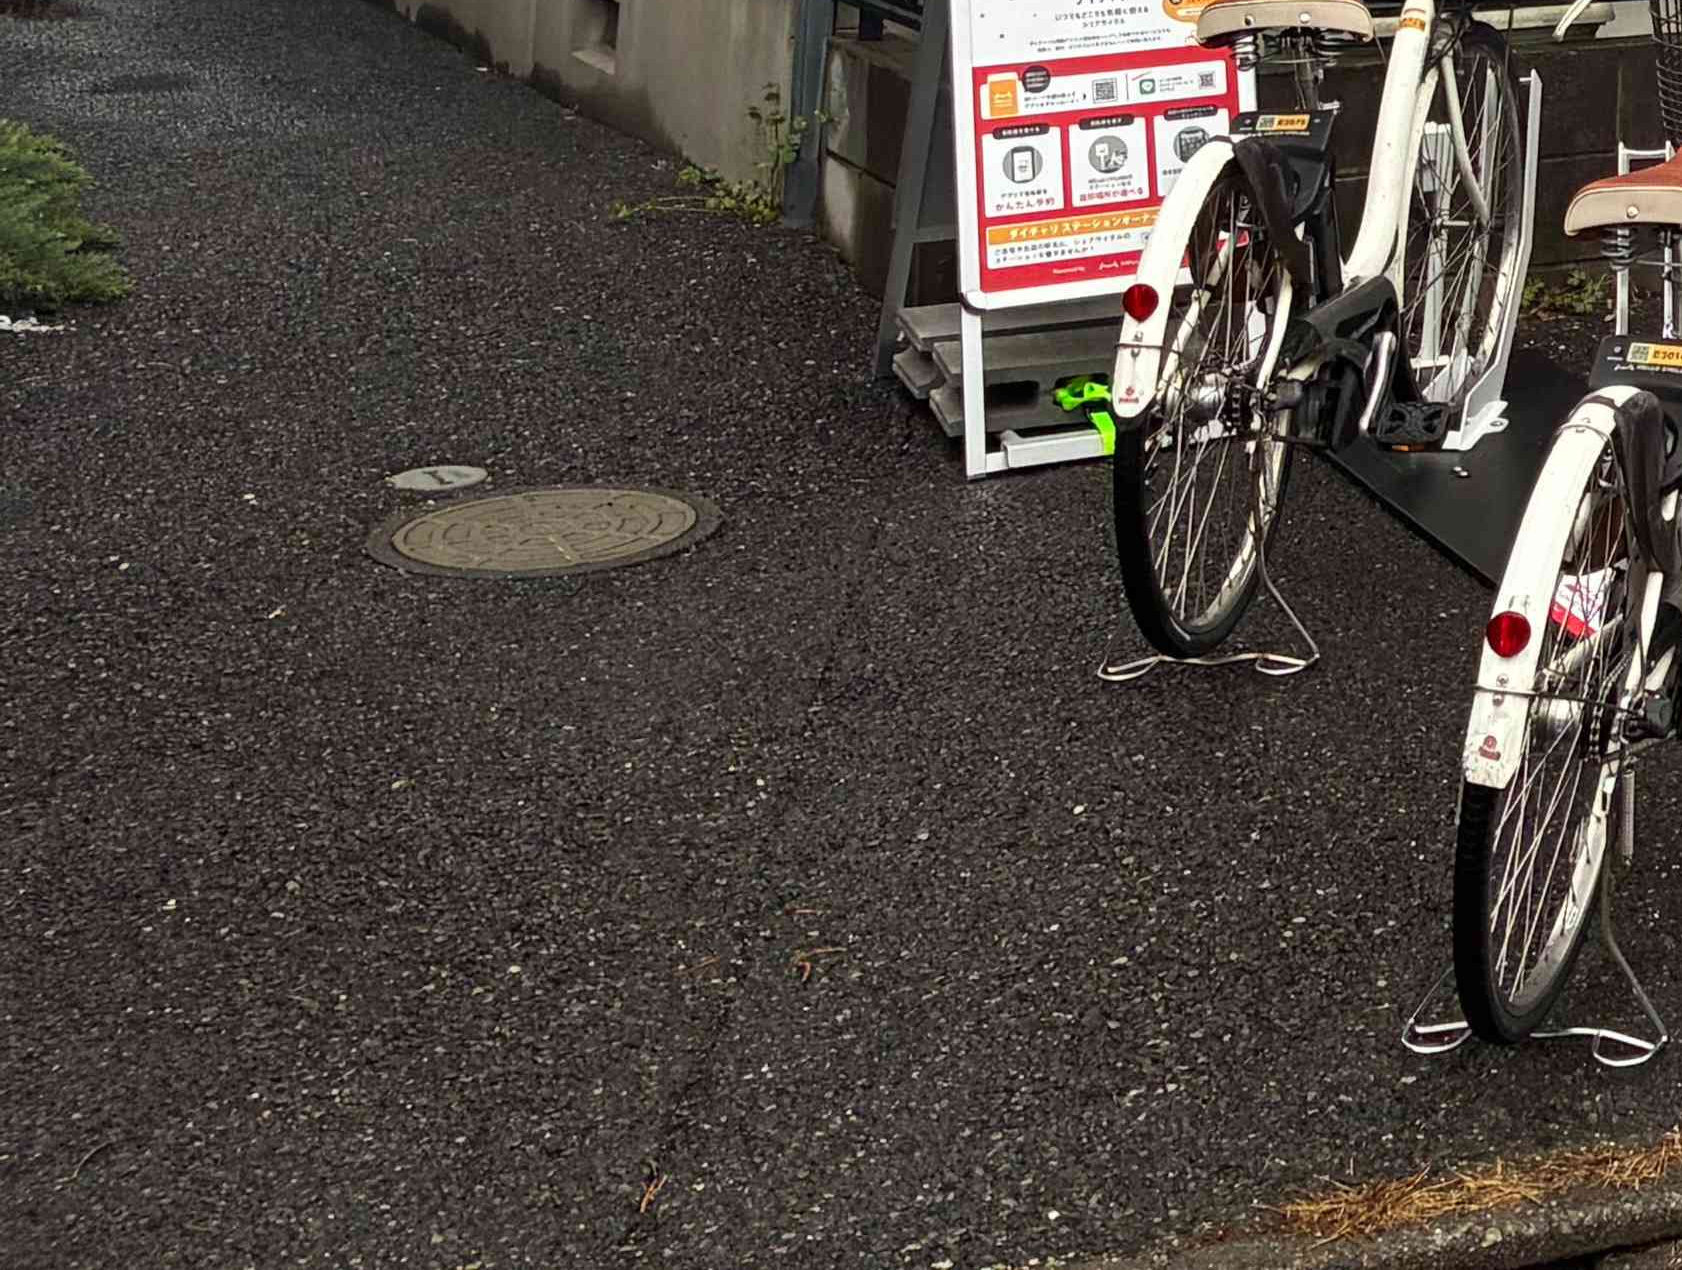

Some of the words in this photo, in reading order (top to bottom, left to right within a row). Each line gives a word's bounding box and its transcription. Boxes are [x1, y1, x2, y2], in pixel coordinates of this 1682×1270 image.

[1009, 225, 1059, 239] ダイチャリ
